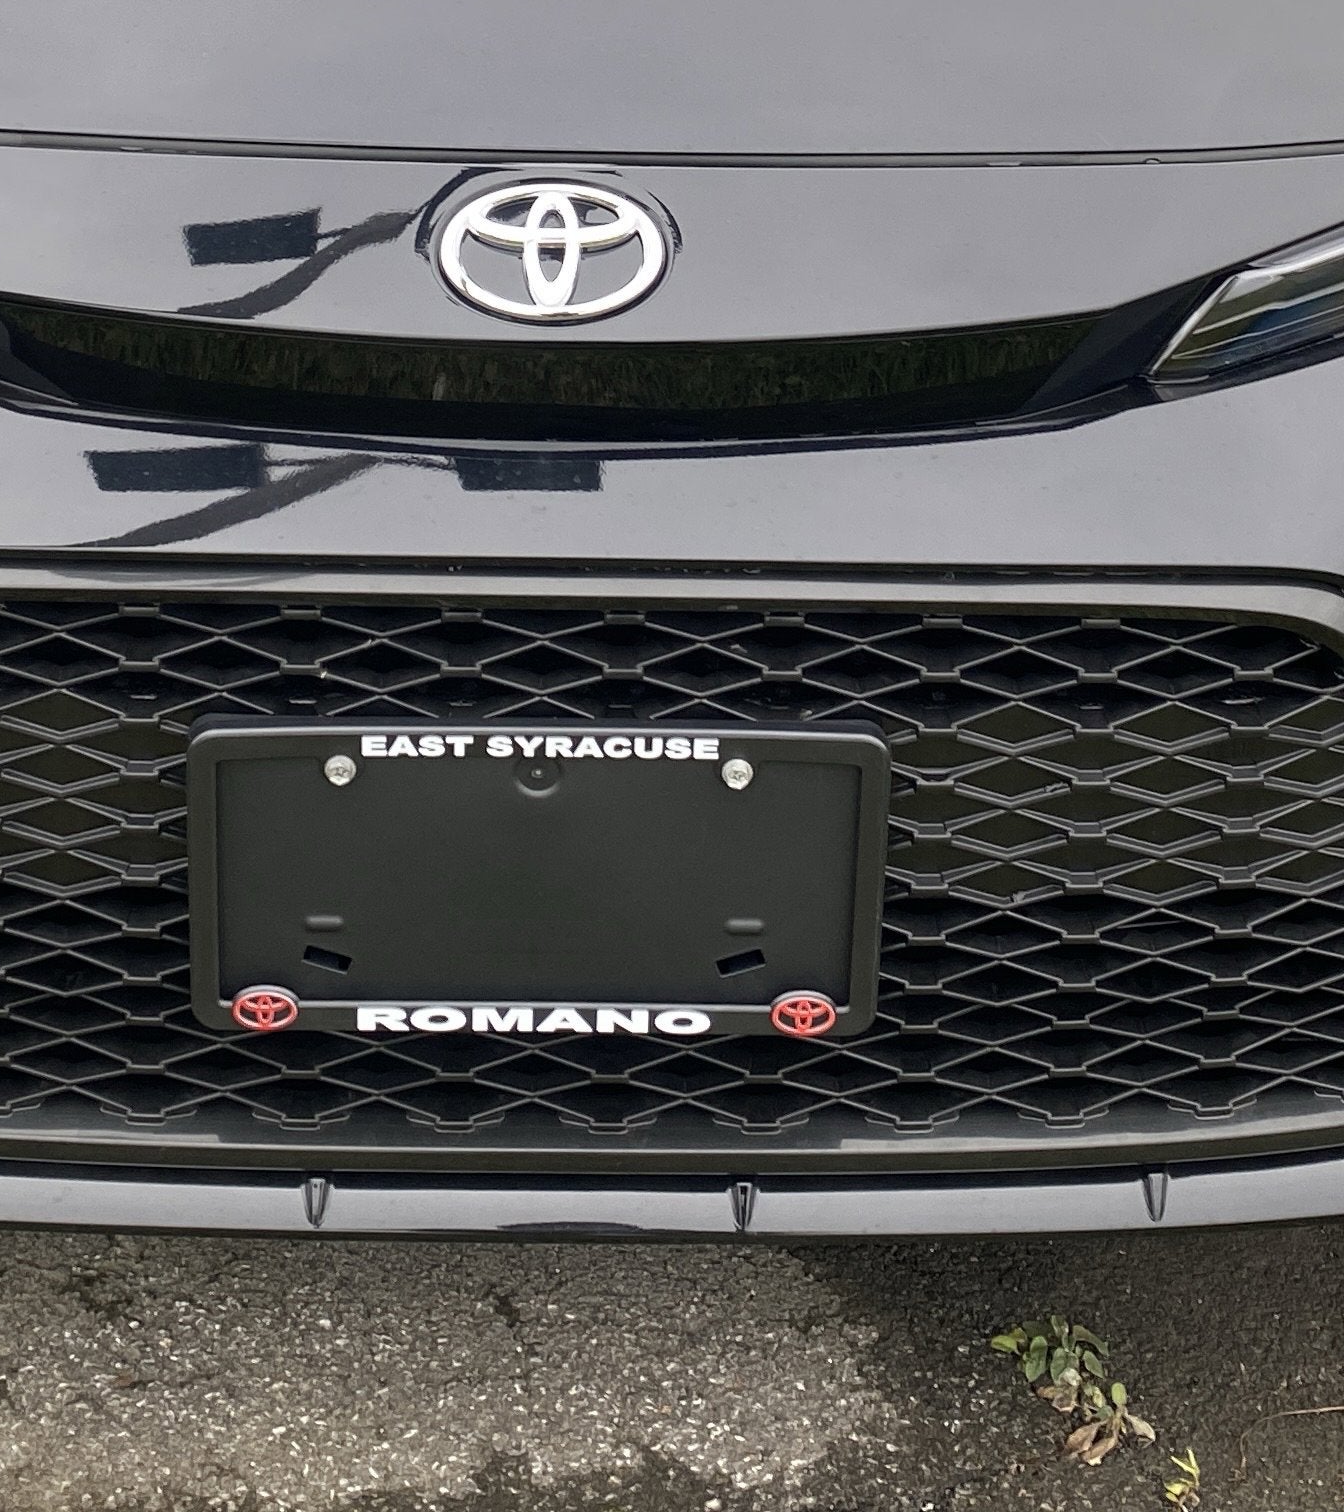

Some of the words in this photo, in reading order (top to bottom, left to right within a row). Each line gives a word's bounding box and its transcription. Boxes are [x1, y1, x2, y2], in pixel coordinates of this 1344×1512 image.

[360, 734, 474, 758] EAST
[486, 735, 720, 761] SYRACUSE
[356, 1006, 712, 1035] ROMANO
